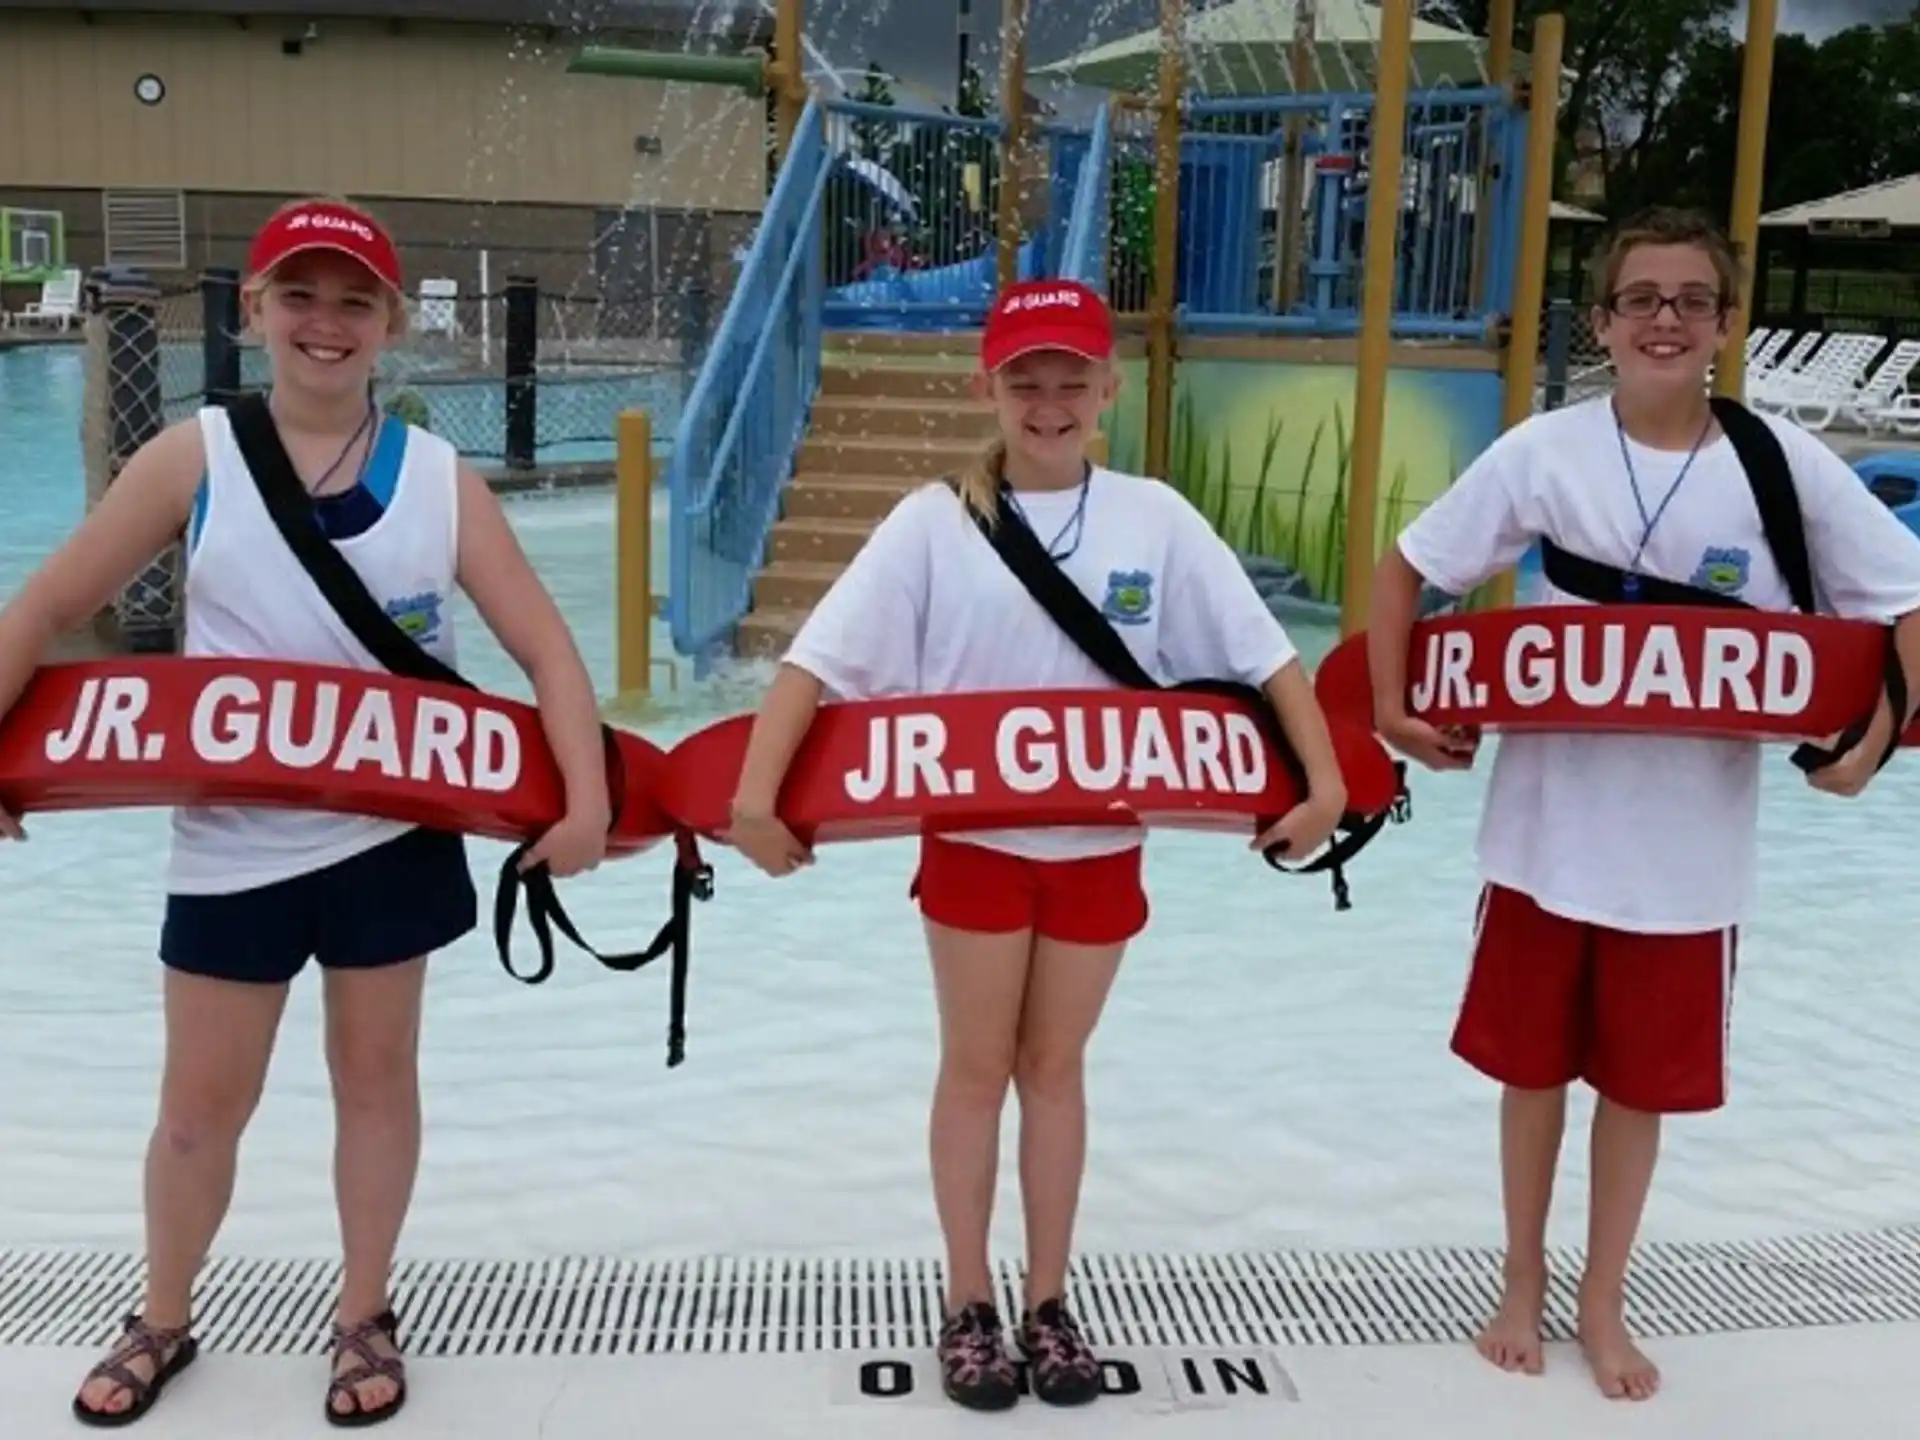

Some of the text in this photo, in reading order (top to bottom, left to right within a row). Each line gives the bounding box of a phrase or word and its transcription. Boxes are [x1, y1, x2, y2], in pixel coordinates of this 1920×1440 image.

[311, 213, 375, 242] GUARD
[1022, 288, 1080, 311] GUARD
[1412, 624, 1814, 716] JR. GUARD
[45, 675, 521, 792] JR. GUARD
[844, 706, 1267, 801] JR. GUARD
[1181, 1357, 1269, 1395] IN
